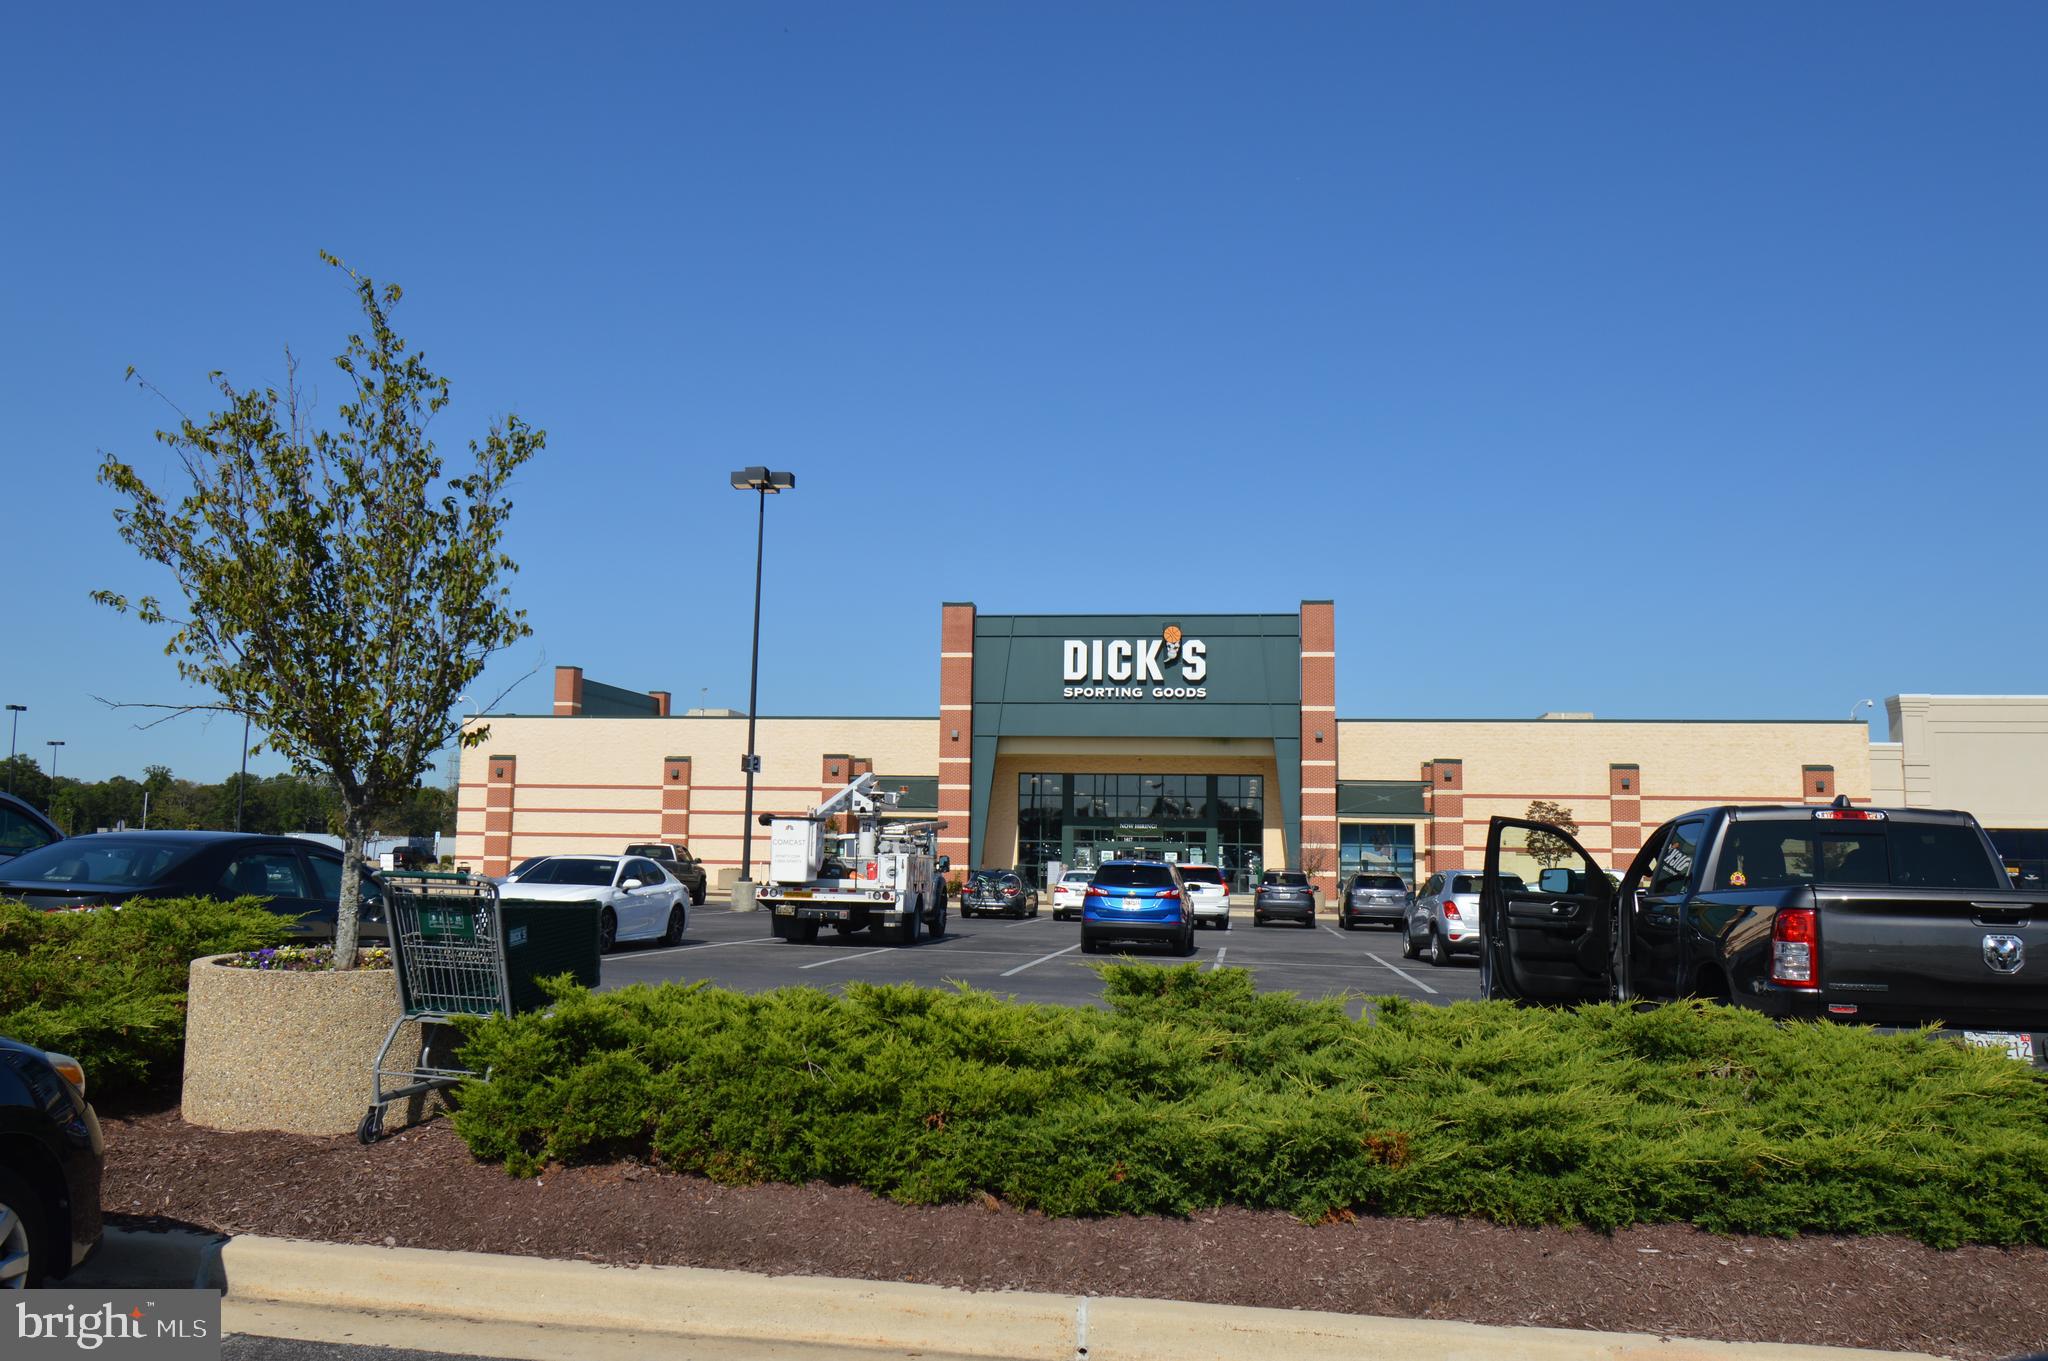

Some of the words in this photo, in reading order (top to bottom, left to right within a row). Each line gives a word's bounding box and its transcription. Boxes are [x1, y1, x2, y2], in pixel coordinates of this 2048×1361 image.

[1064, 626, 1206, 681] DICK'S
[1063, 687, 1143, 698] SPORTING
[1152, 687, 1207, 698] GOODS
